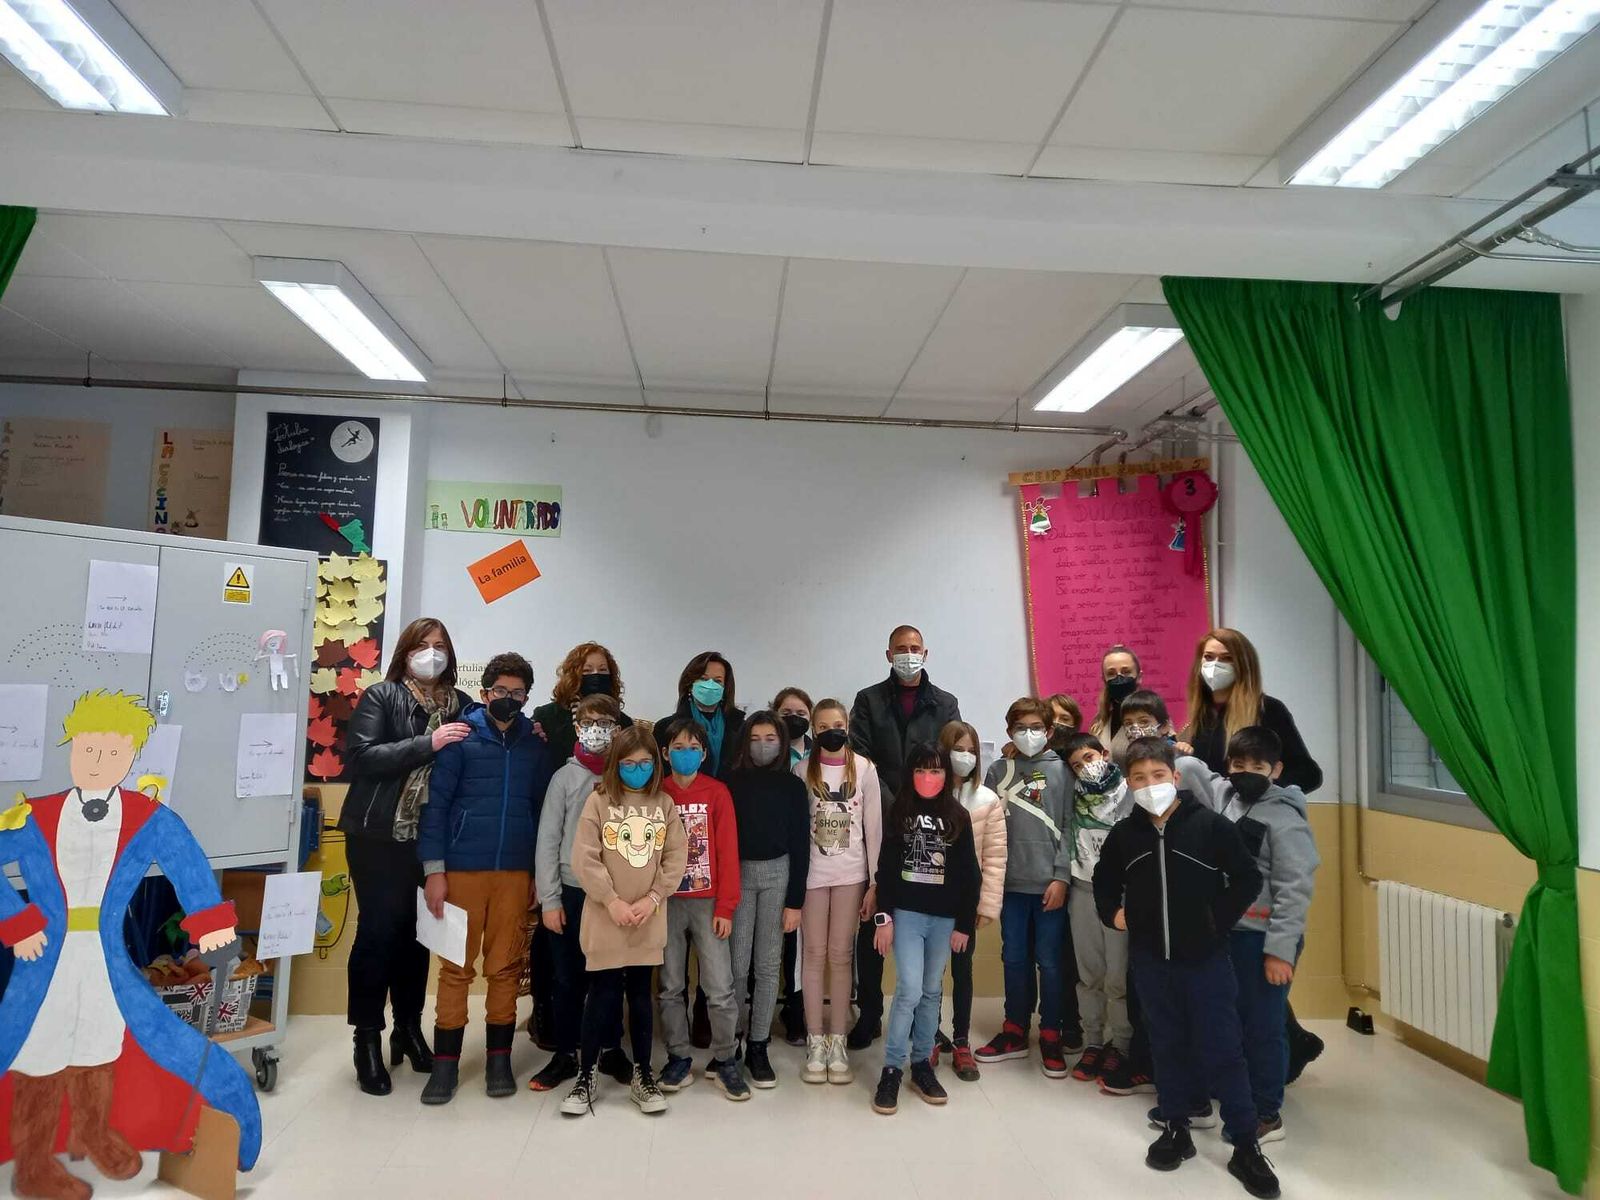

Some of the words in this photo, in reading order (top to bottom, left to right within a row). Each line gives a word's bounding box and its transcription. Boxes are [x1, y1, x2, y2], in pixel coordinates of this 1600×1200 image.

[1184, 477, 1197, 496] 3
[478, 575, 491, 584] La
[491, 554, 527, 577] familia
[608, 805, 665, 821] NALA
[819, 818, 847, 829] SHOW
